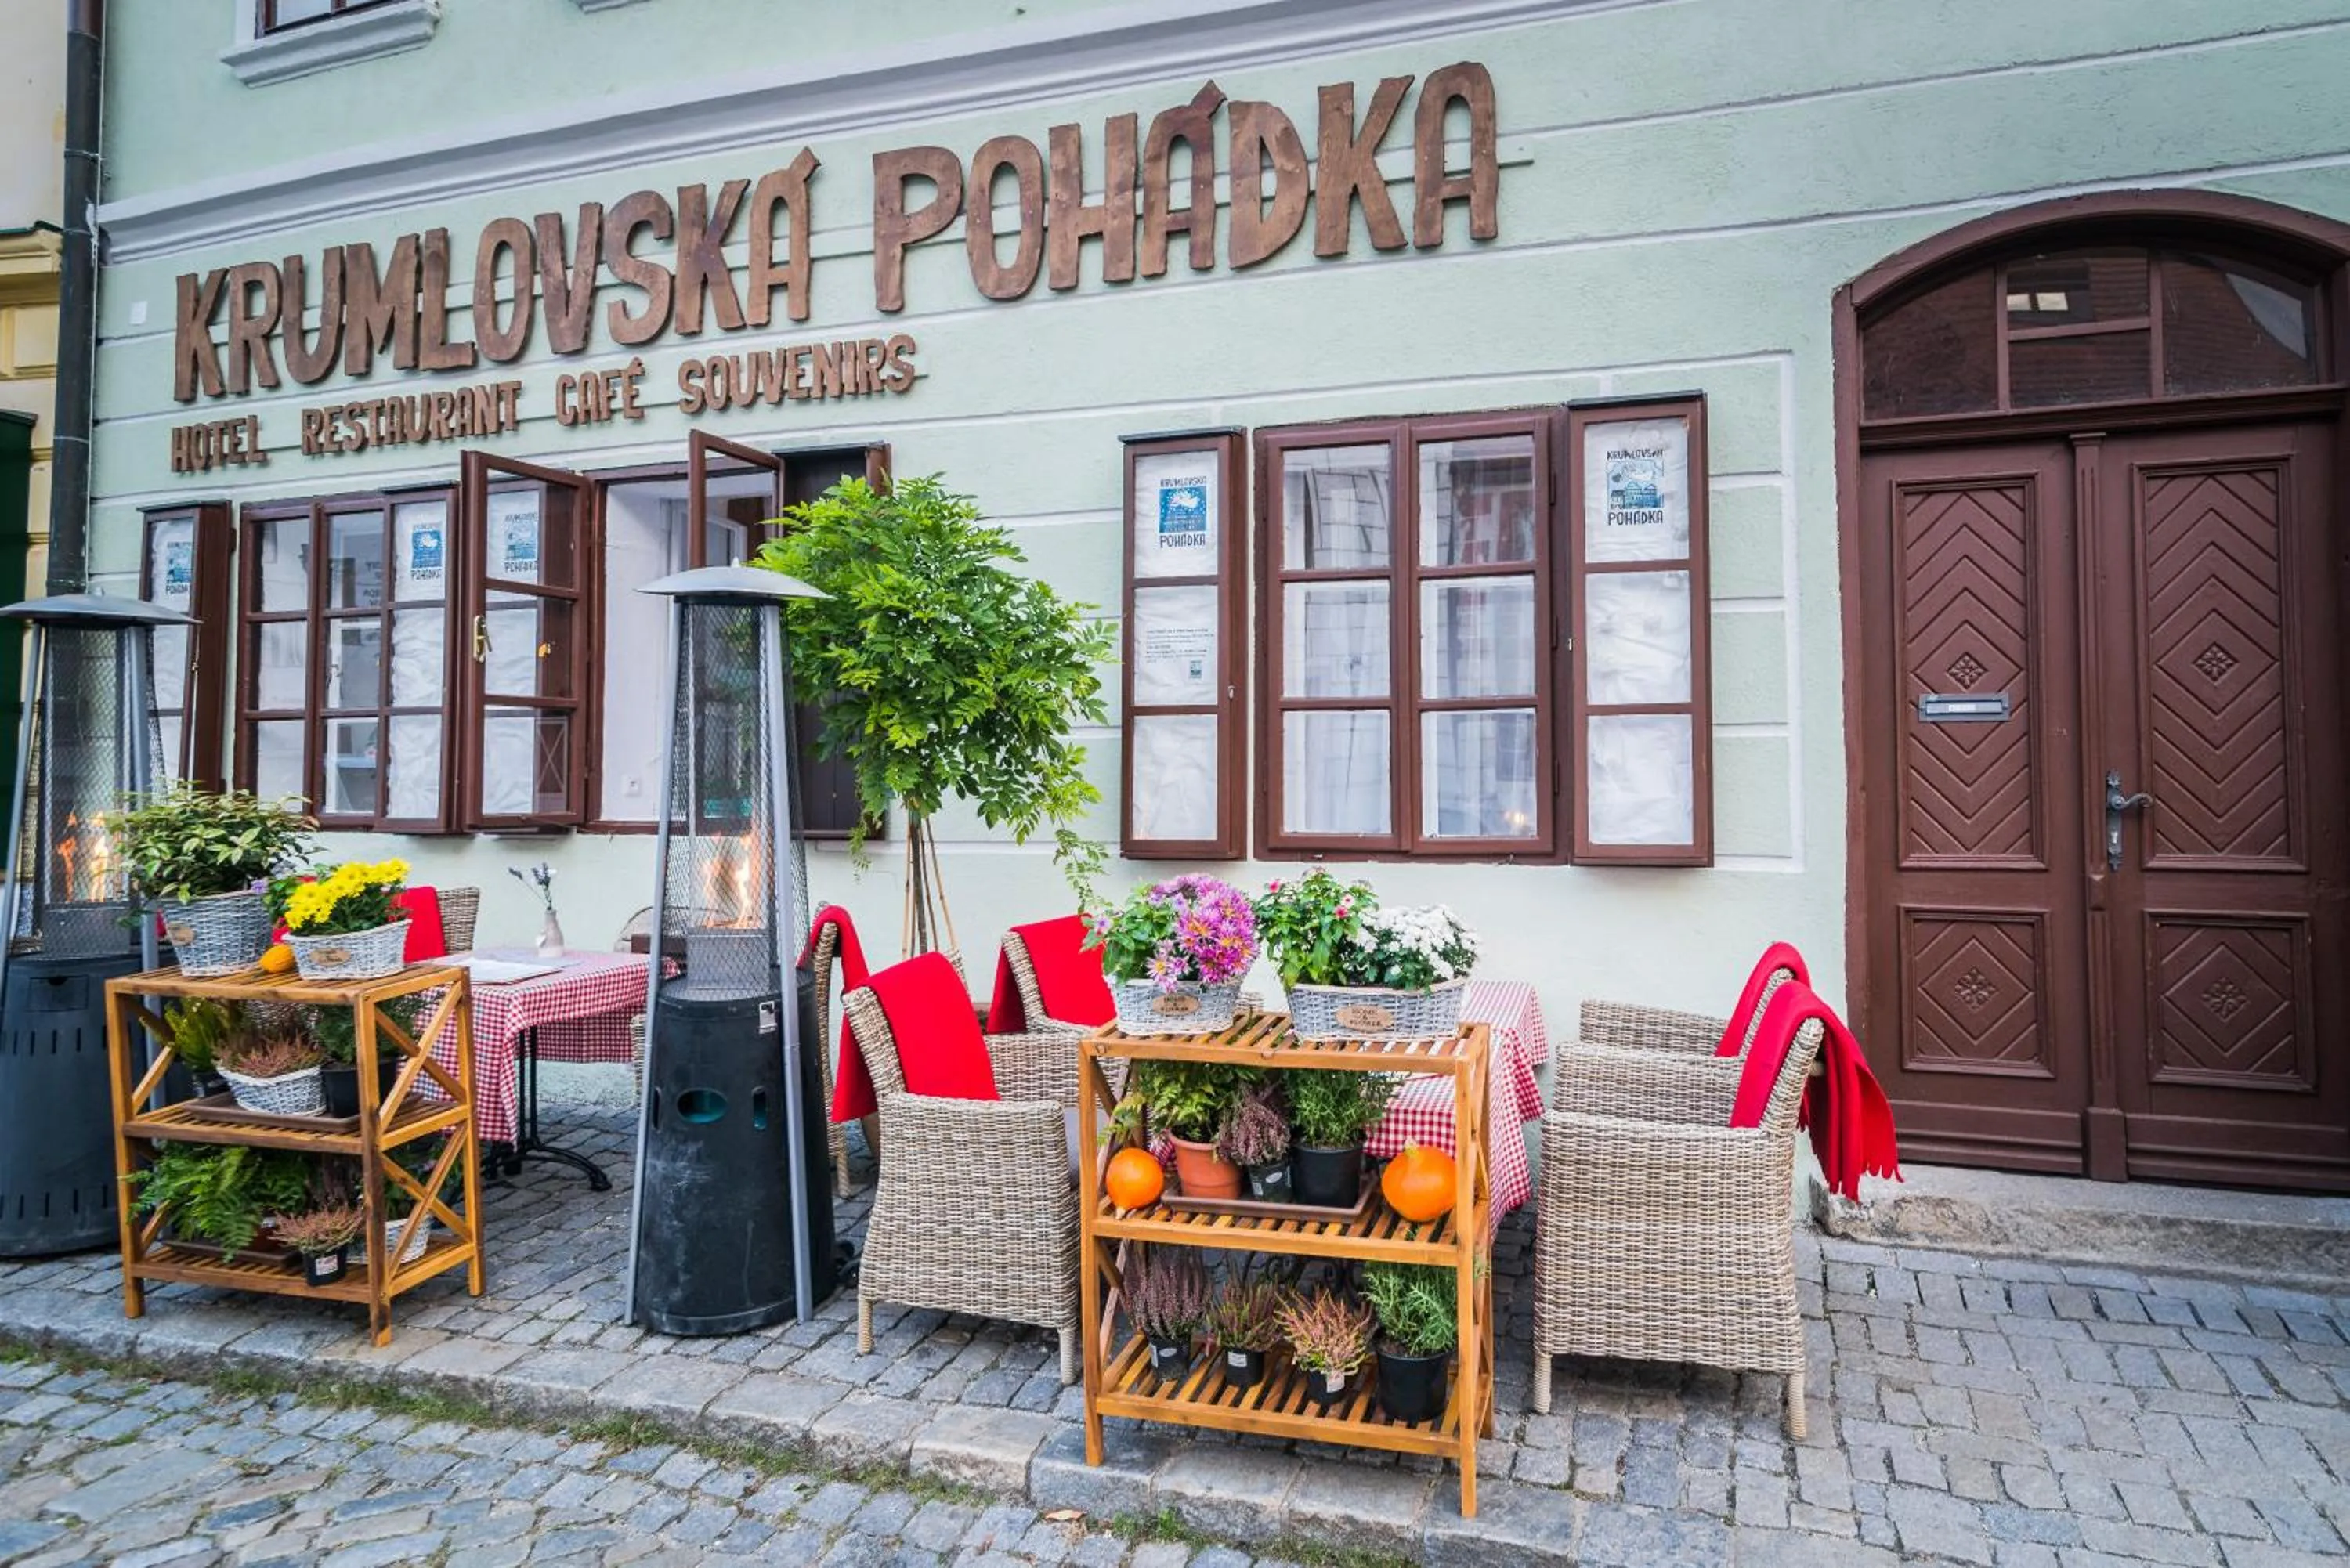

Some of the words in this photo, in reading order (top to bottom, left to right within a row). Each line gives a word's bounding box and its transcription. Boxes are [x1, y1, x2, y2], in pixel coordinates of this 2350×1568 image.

[174, 146, 821, 403] KRUMLOVSKÁ
[873, 61, 1499, 313] POHÁDKA
[172, 414, 267, 472] HOTEL
[302, 380, 523, 455] RESTAURANT
[555, 356, 645, 426] CAFÉ
[678, 334, 916, 415] SOUVENIRS
